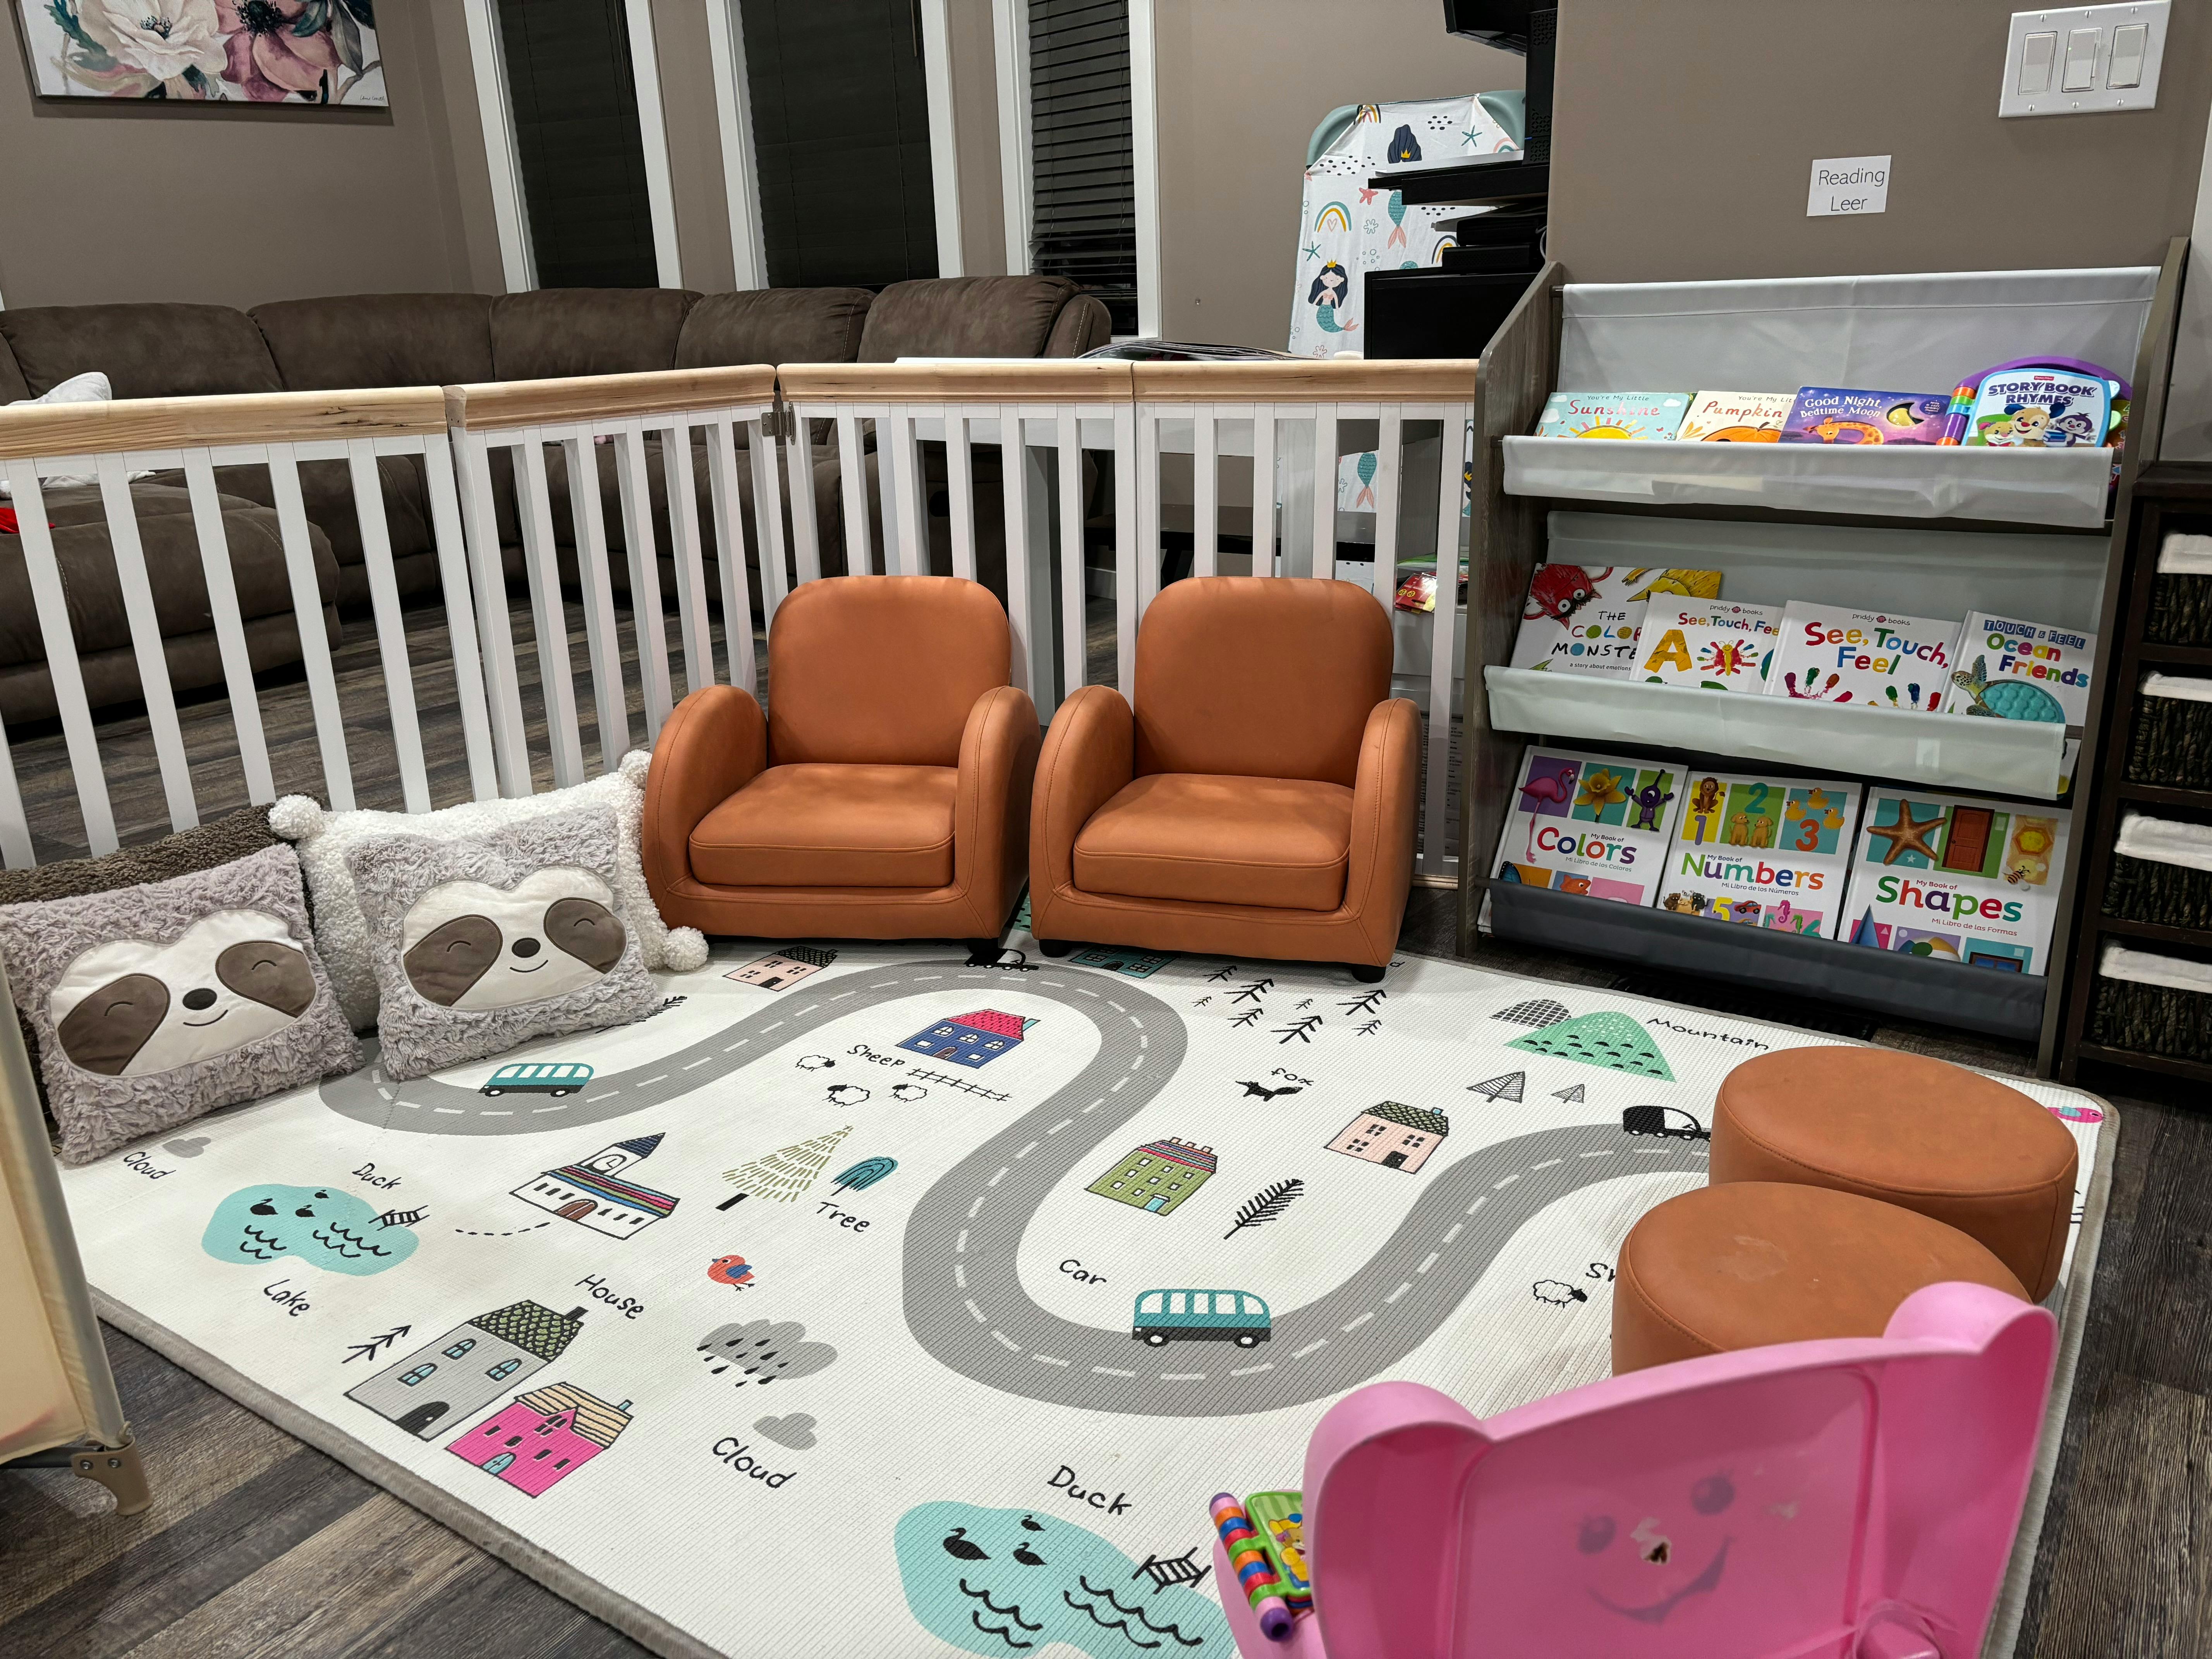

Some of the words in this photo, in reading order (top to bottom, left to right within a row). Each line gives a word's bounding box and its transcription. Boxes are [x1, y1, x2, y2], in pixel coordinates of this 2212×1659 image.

[1819, 168, 1885, 187] Reading
[1831, 195, 1868, 211] Leer
[1568, 399, 1660, 416] Sunshine
[1702, 400, 1782, 422] Pumpkin
[1800, 409, 1844, 418] Bedtime
[1848, 407, 1881, 417] Moon
[1805, 396, 1839, 408] Good
[1843, 396, 1882, 409] Night,
[2006, 394, 2074, 405] RHYMES
[1599, 611, 1626, 620] THE
[1743, 606, 1763, 615] books
[1852, 614, 1874, 622] priddy
[1888, 616, 1910, 625] books
[1678, 612, 1710, 627] See,
[1711, 616, 1752, 632] Touch,
[1754, 620, 1779, 636] Fee
[1986, 620, 2034, 637] TOUCH
[2049, 631, 2085, 648] FEEL
[1551, 642, 1637, 659] MONSTE
[1644, 629, 1692, 673] A
[1805, 622, 1869, 646] See,
[1874, 627, 1949, 669] Touch,
[1987, 633, 2061, 662] Ocean
[1837, 646, 1901, 675] Feel
[1999, 654, 2089, 687] Friends
[1745, 782, 1769, 814] 2
[1695, 815, 1707, 845] 1
[1795, 819, 1820, 852] 3
[1537, 827, 1637, 864] Colors
[1609, 864, 1632, 872] Colores
[1681, 852, 1825, 890] Numbers
[1769, 887, 1799, 896] Números
[1929, 881, 1948, 890] Book
[1875, 876, 2023, 922] Shapes
[1942, 919, 1962, 928] Libro
[1987, 927, 2018, 936] Formas
[1646, 1018, 1769, 1050] Mountain
[847, 1045, 905, 1067] Sheep
[124, 1152, 176, 1179] Cloud
[352, 1163, 402, 1189] Duck
[816, 1202, 870, 1233] Tree
[1059, 1259, 1107, 1284] Car
[264, 1279, 310, 1317] Lake
[574, 1274, 644, 1319] House
[713, 1437, 797, 1489] Cloud
[1047, 1465, 1132, 1515] Duck
